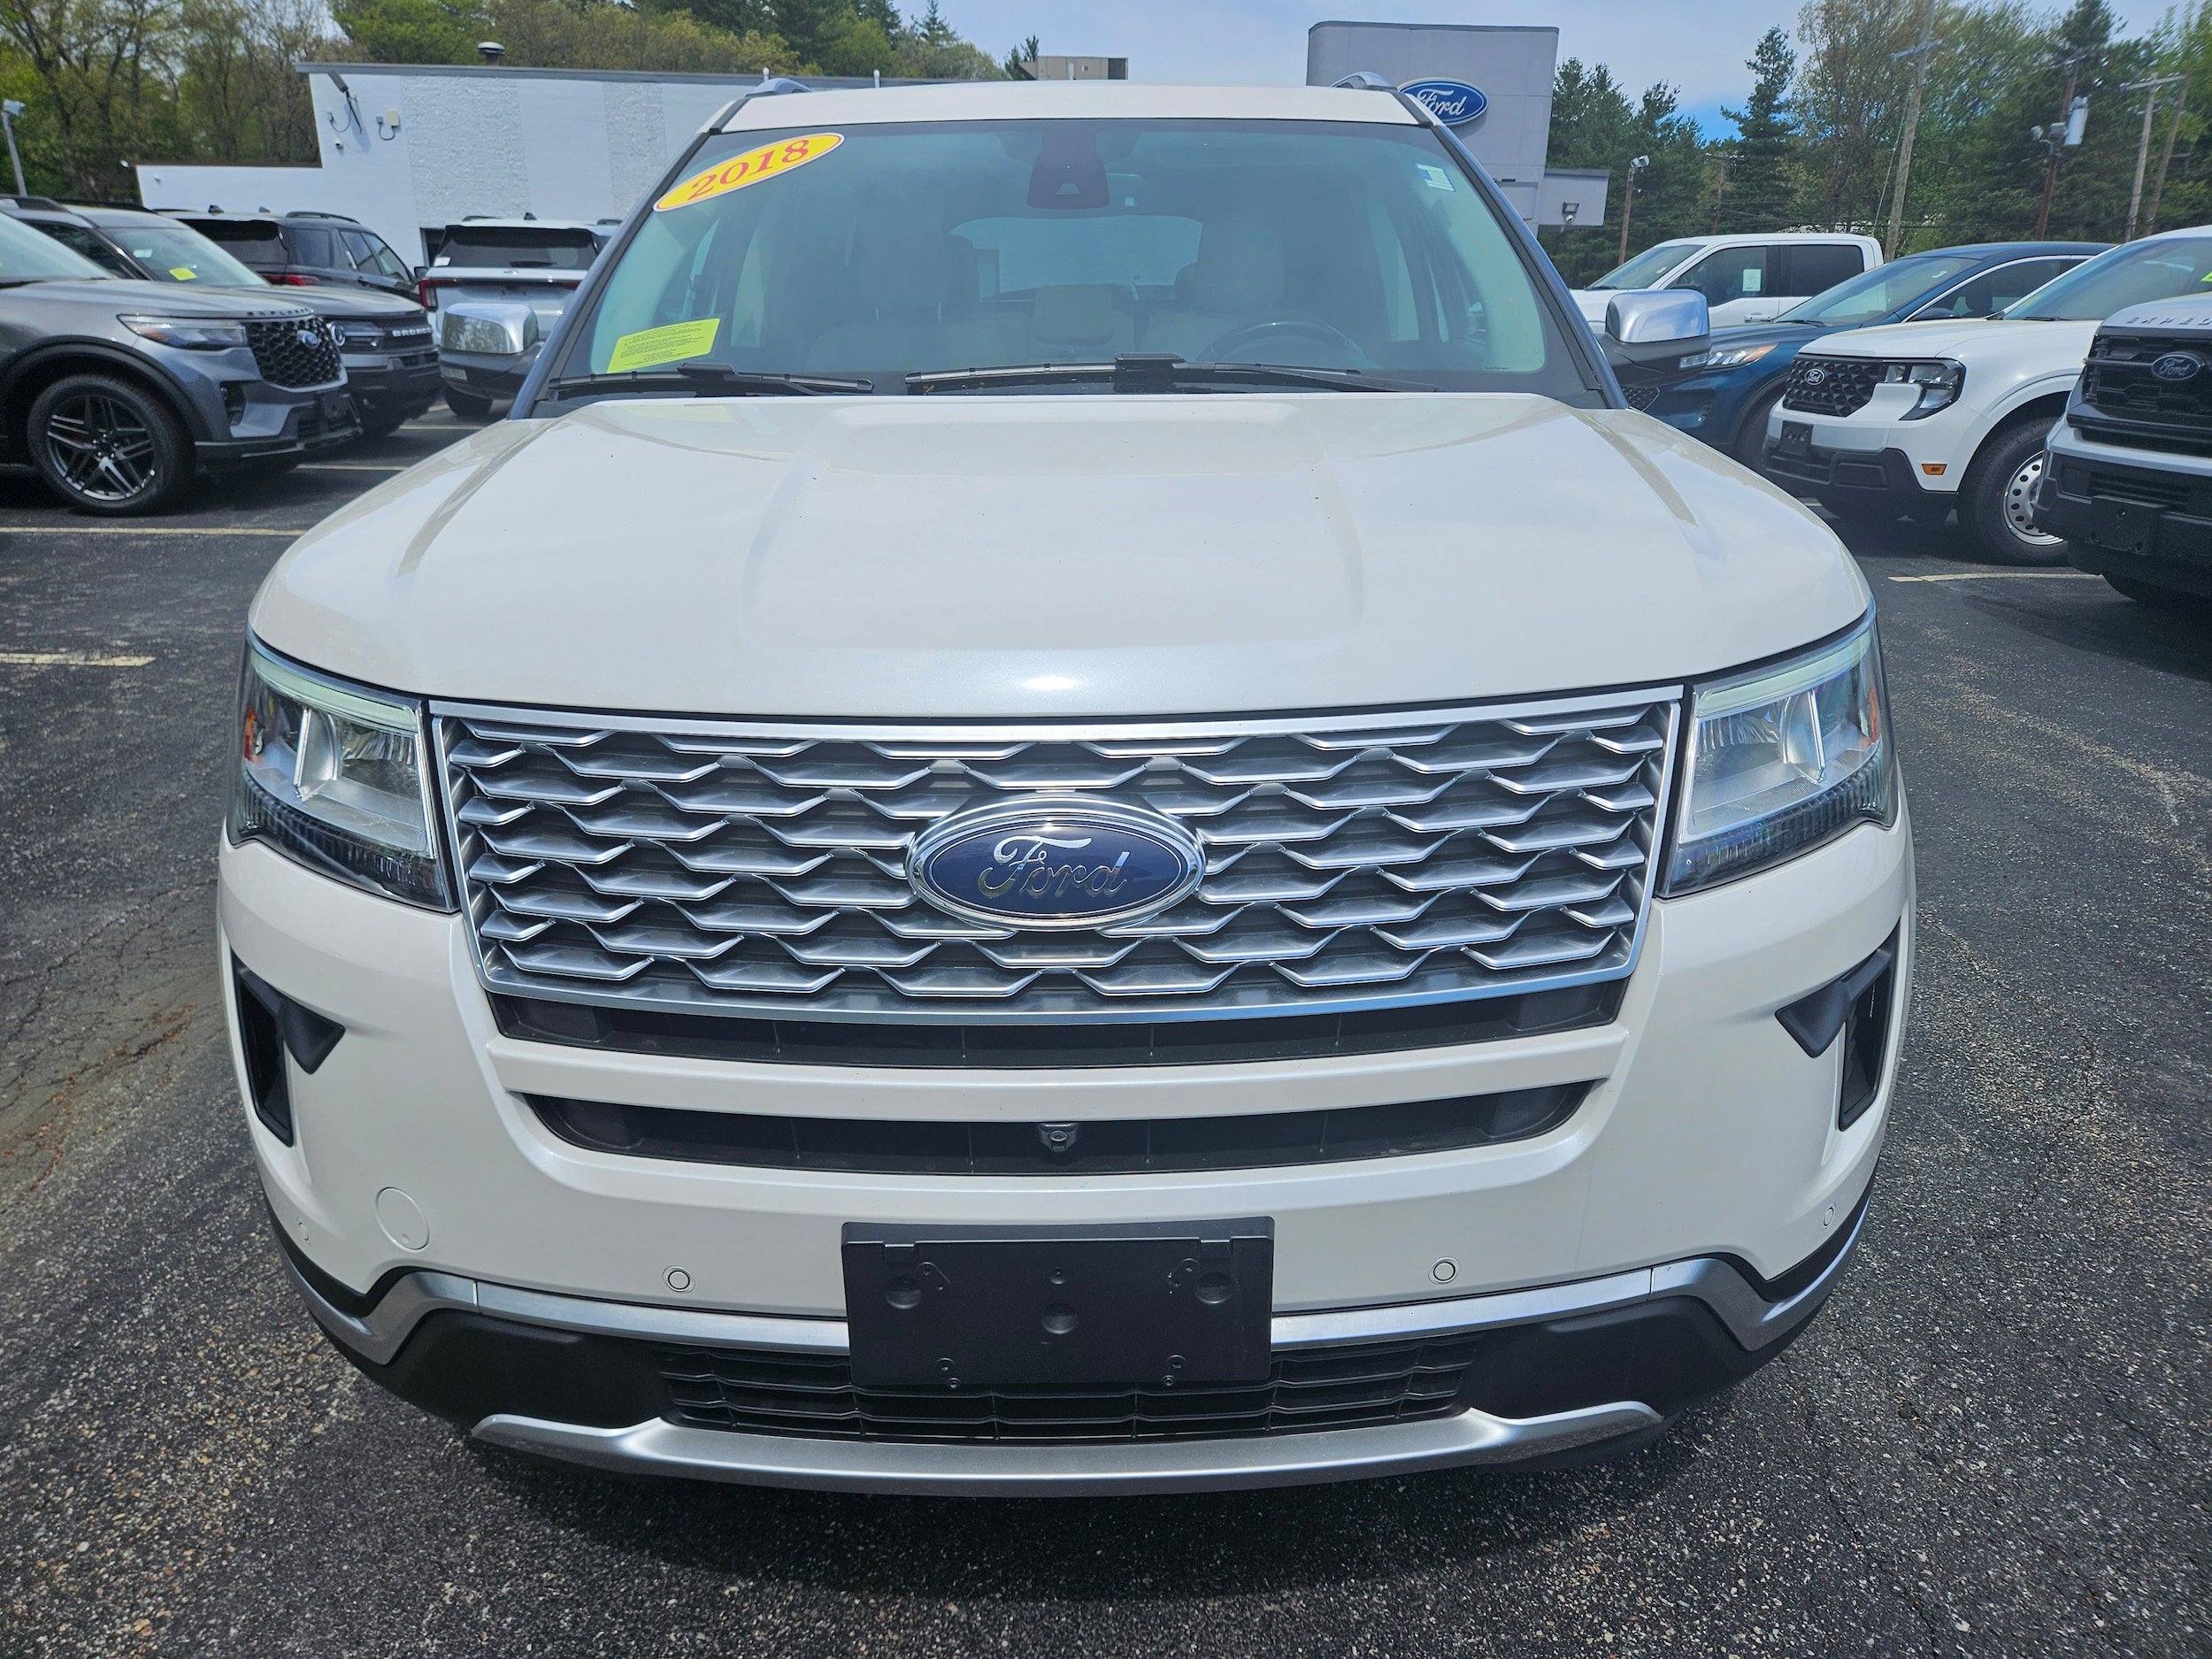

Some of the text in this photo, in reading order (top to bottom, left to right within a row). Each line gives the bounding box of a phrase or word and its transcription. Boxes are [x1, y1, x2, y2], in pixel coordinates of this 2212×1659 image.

[1417, 88, 1467, 116] Ford
[687, 139, 810, 201] 2018
[2159, 357, 2193, 377] Ford
[978, 835, 1131, 899] Ford
